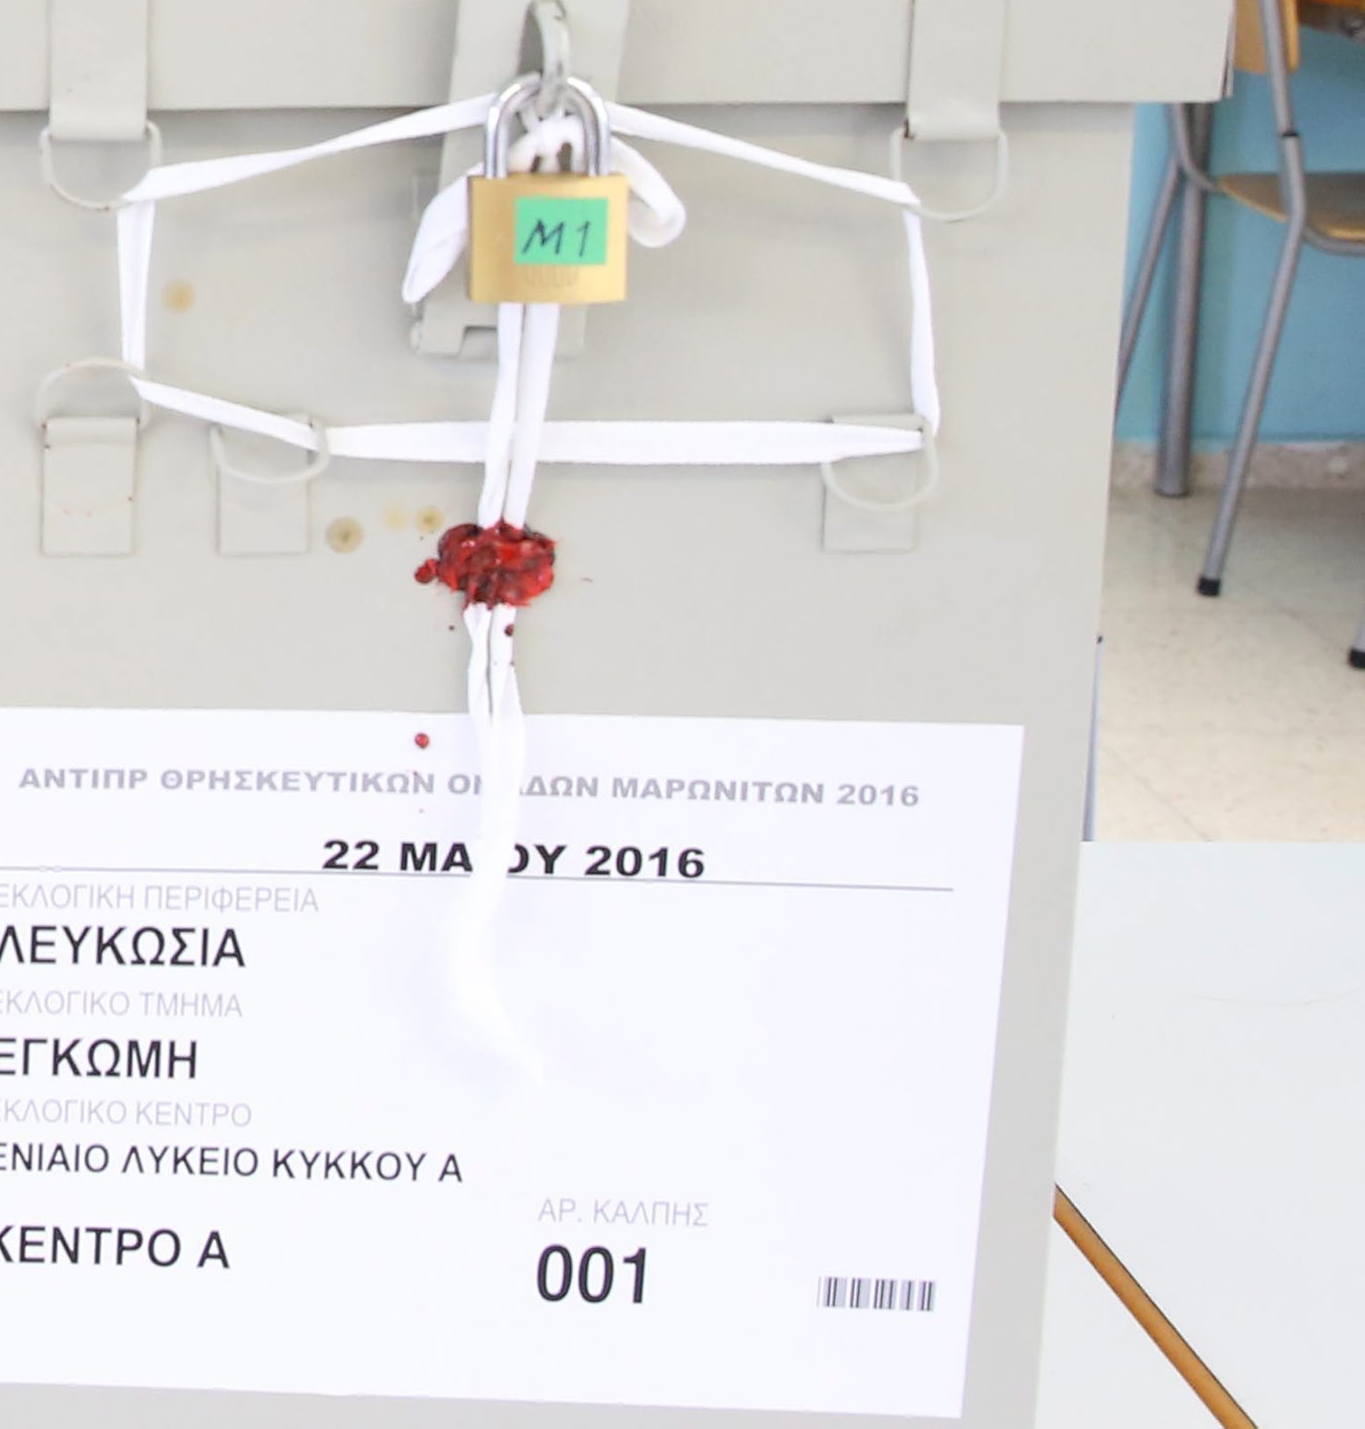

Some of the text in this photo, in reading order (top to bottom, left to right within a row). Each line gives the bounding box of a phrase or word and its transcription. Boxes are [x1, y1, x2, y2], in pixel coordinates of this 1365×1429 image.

[18, 767, 920, 808] ΑΝΤΙΠΡ ΘΡΗΣΚΕΥΤΙΚΩΝ ΟΔΩΝ ΜΑΡΩΝΙΤΩΝ 2016
[322, 838, 381, 873] 22
[584, 845, 706, 880] 2016
[144, 884, 319, 914] ΠΕΡΙΦΕΡΕΙΑ
[138, 991, 243, 1018] ΤΜΗΜΑ
[135, 1101, 252, 1128] ΚΕΝΤΡΟ
[120, 1144, 260, 1178] ΛΥΚΕΙΟ
[271, 1147, 429, 1183] ΚΥΚΚΟΥ
[436, 1152, 464, 1184] Α
[537, 1197, 709, 1227] ΑΡ. ΚΑΛΠΗΣ
[195, 1228, 232, 1271] Α
[535, 1242, 648, 1306] 001
